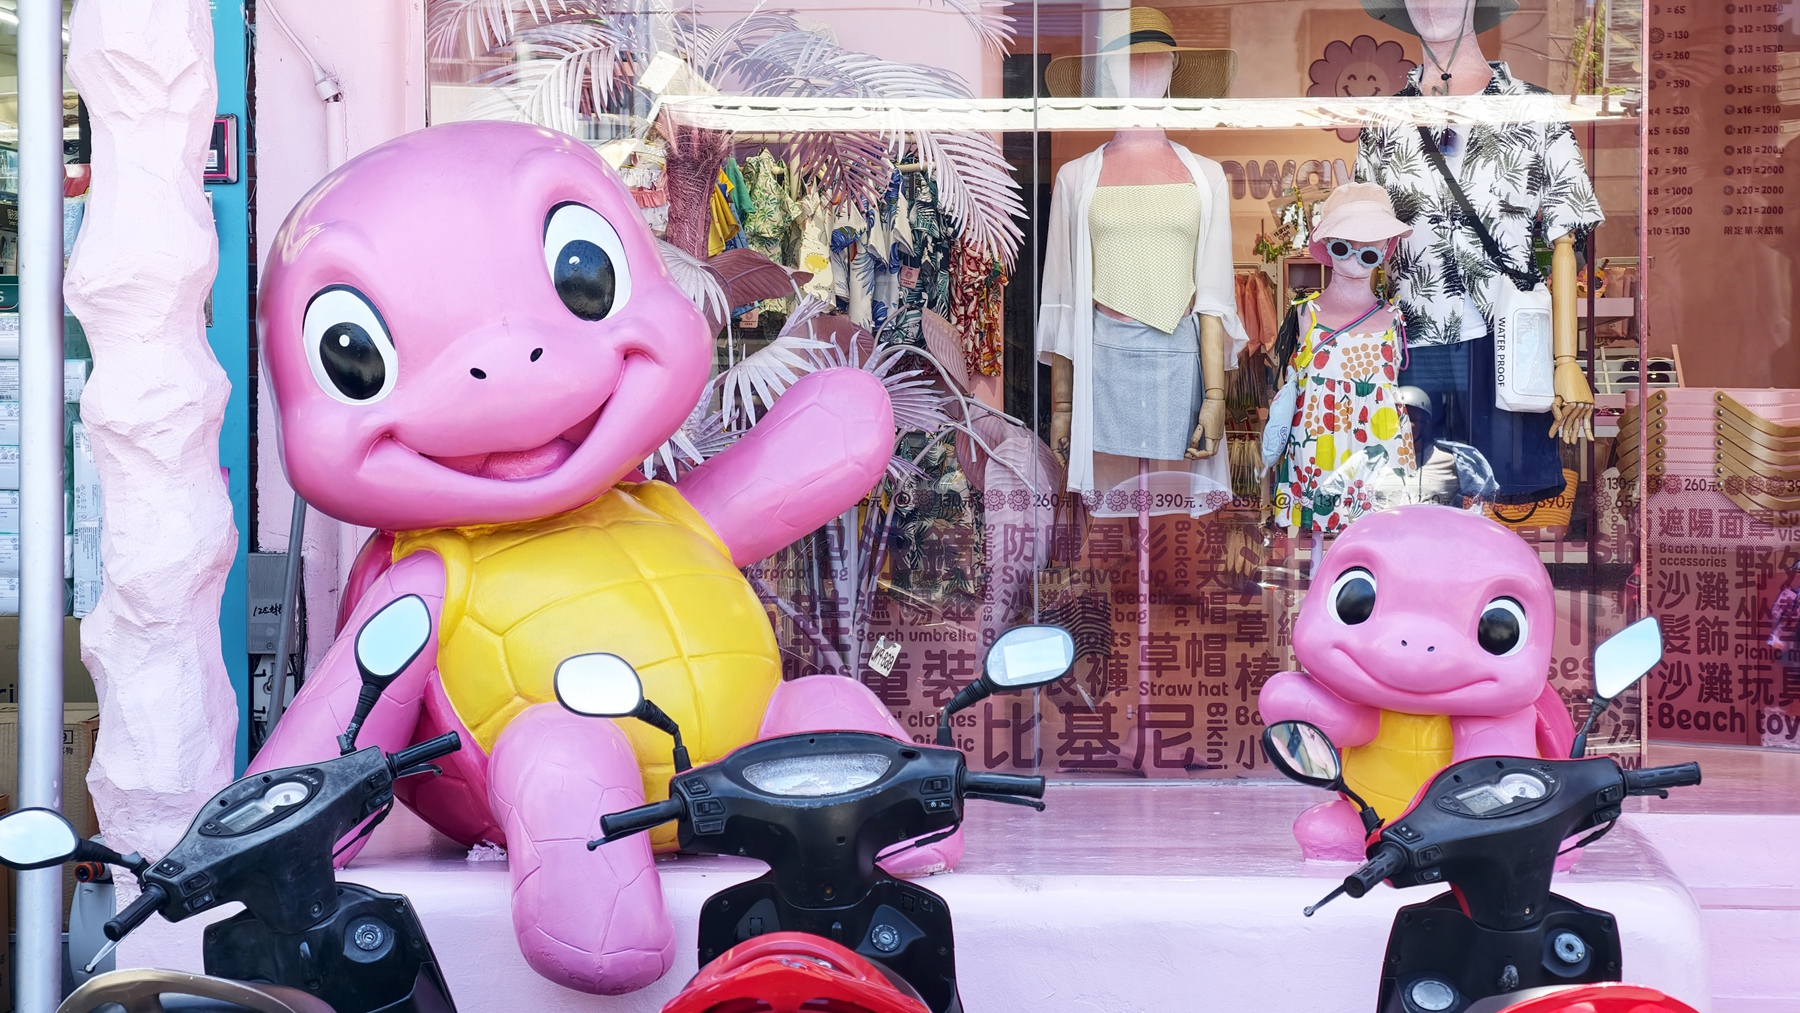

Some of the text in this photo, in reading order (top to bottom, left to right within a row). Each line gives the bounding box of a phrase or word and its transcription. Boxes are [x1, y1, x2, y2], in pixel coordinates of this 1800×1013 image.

[1496, 317, 1506, 388] WATER PROOF
[983, 523, 995, 562] Swim
[1003, 522, 1168, 563] 防曬罩衫
[1175, 520, 1192, 587] Bucket
[1660, 543, 1697, 554] Beach
[1002, 565, 1168, 588] Swim cover-up
[1660, 556, 1727, 568] accessories
[1115, 608, 1148, 625] bag
[857, 628, 977, 643] Beach umbrella
[1138, 631, 1228, 679] 草帽
[1139, 680, 1229, 697] Straw hat
[983, 701, 1195, 770] 比基尼
[1206, 702, 1228, 770] Bikini
[1658, 703, 1745, 734] Beach
